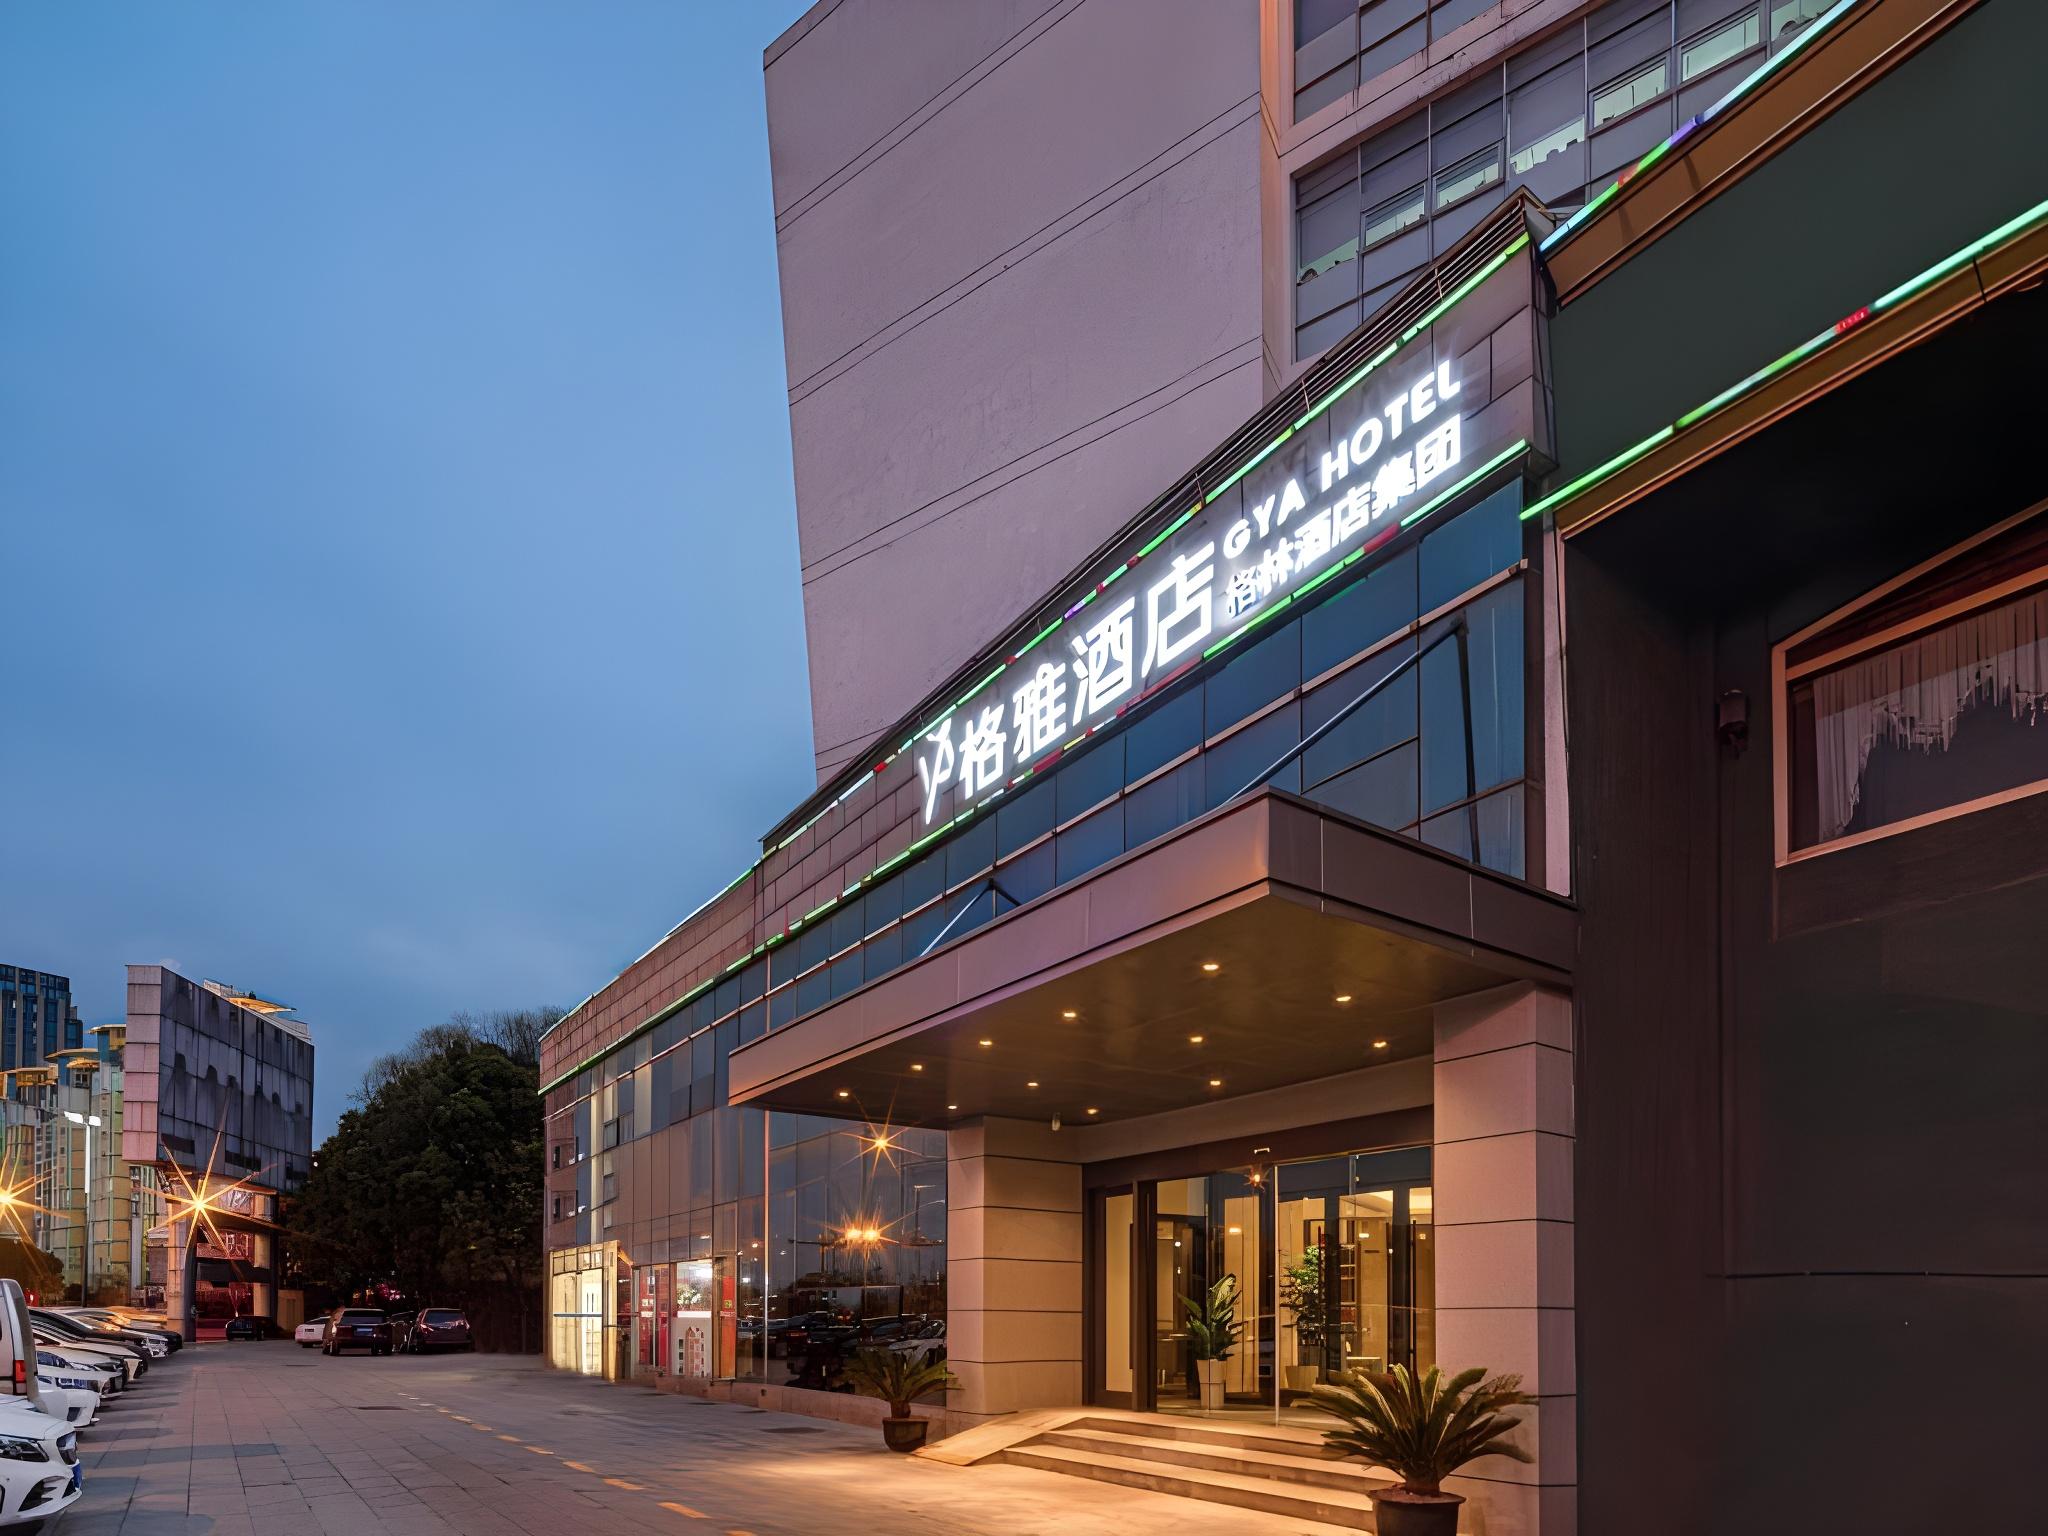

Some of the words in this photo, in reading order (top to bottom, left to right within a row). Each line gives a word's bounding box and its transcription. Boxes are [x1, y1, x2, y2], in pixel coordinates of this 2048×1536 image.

[1223, 478, 1306, 559] GYA
[1321, 359, 1462, 493] HOTEL
[958, 540, 1216, 800] 格雅酒店
